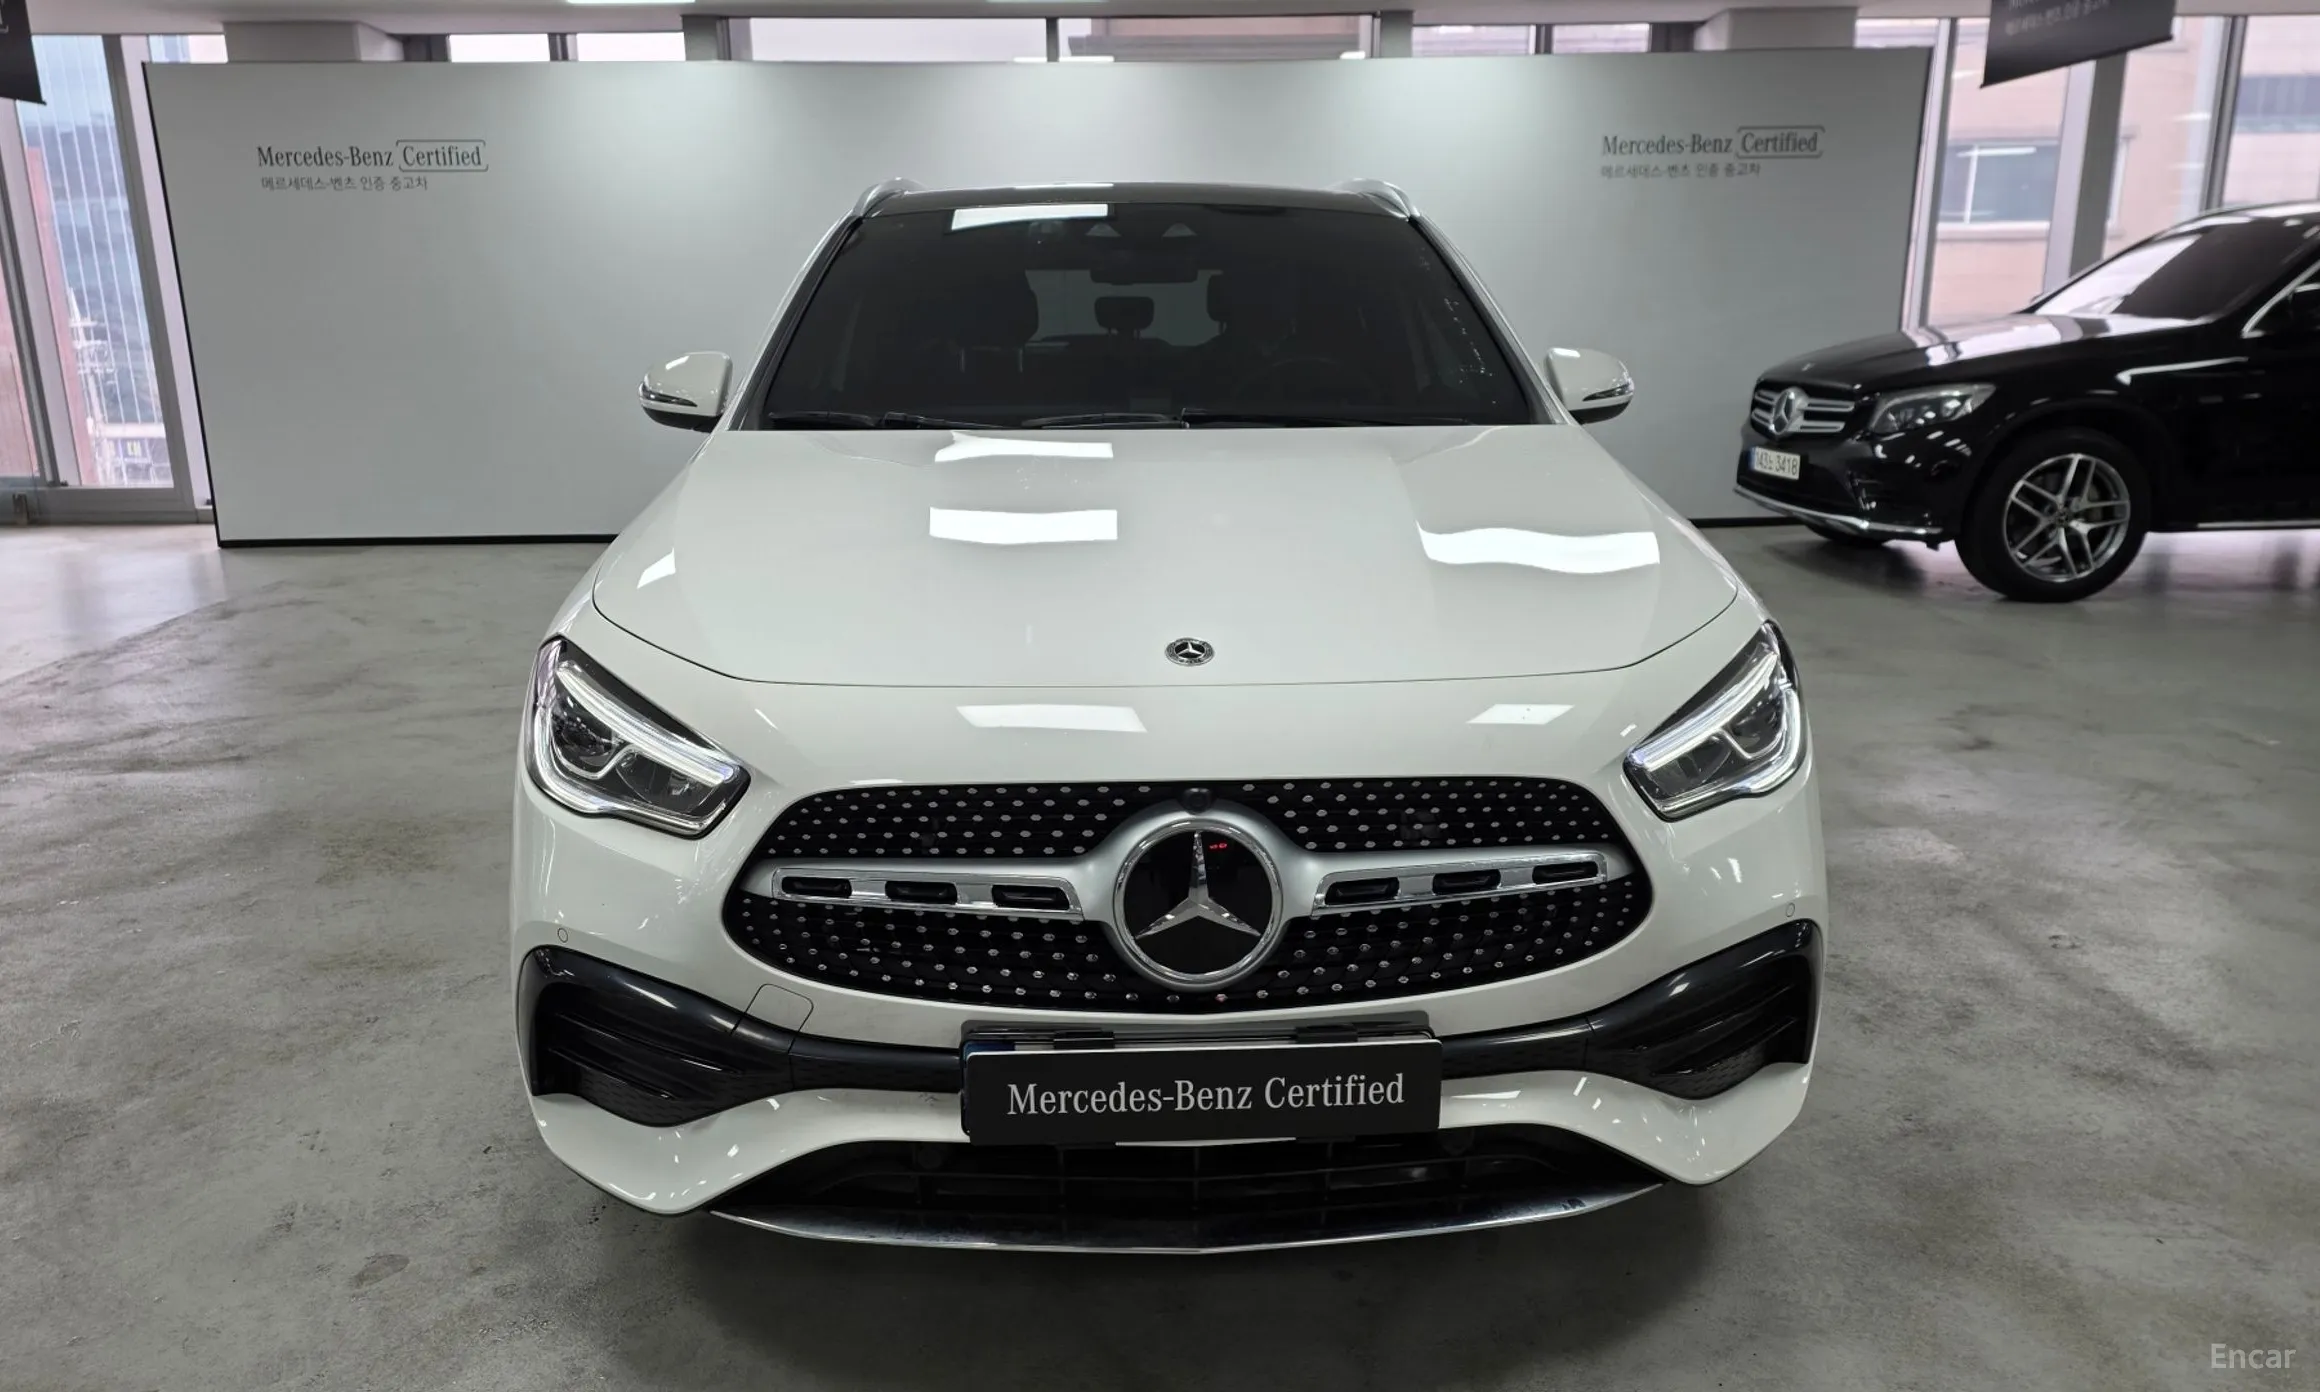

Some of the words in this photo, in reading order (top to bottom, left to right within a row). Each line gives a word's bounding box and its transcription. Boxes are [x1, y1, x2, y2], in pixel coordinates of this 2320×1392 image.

[1603, 133, 1732, 155] Mercedes-Benz
[1741, 132, 1818, 153] Certified
[257, 146, 393, 167] Mercedes-Benz
[402, 145, 482, 167] Certified
[261, 176, 357, 191] 메르세데스-벤츠
[360, 176, 385, 191] 인증
[390, 176, 428, 191] 중고차
[1007, 1080, 1253, 1115] Mercedes-Benz
[1264, 1073, 1405, 1108] Certified
